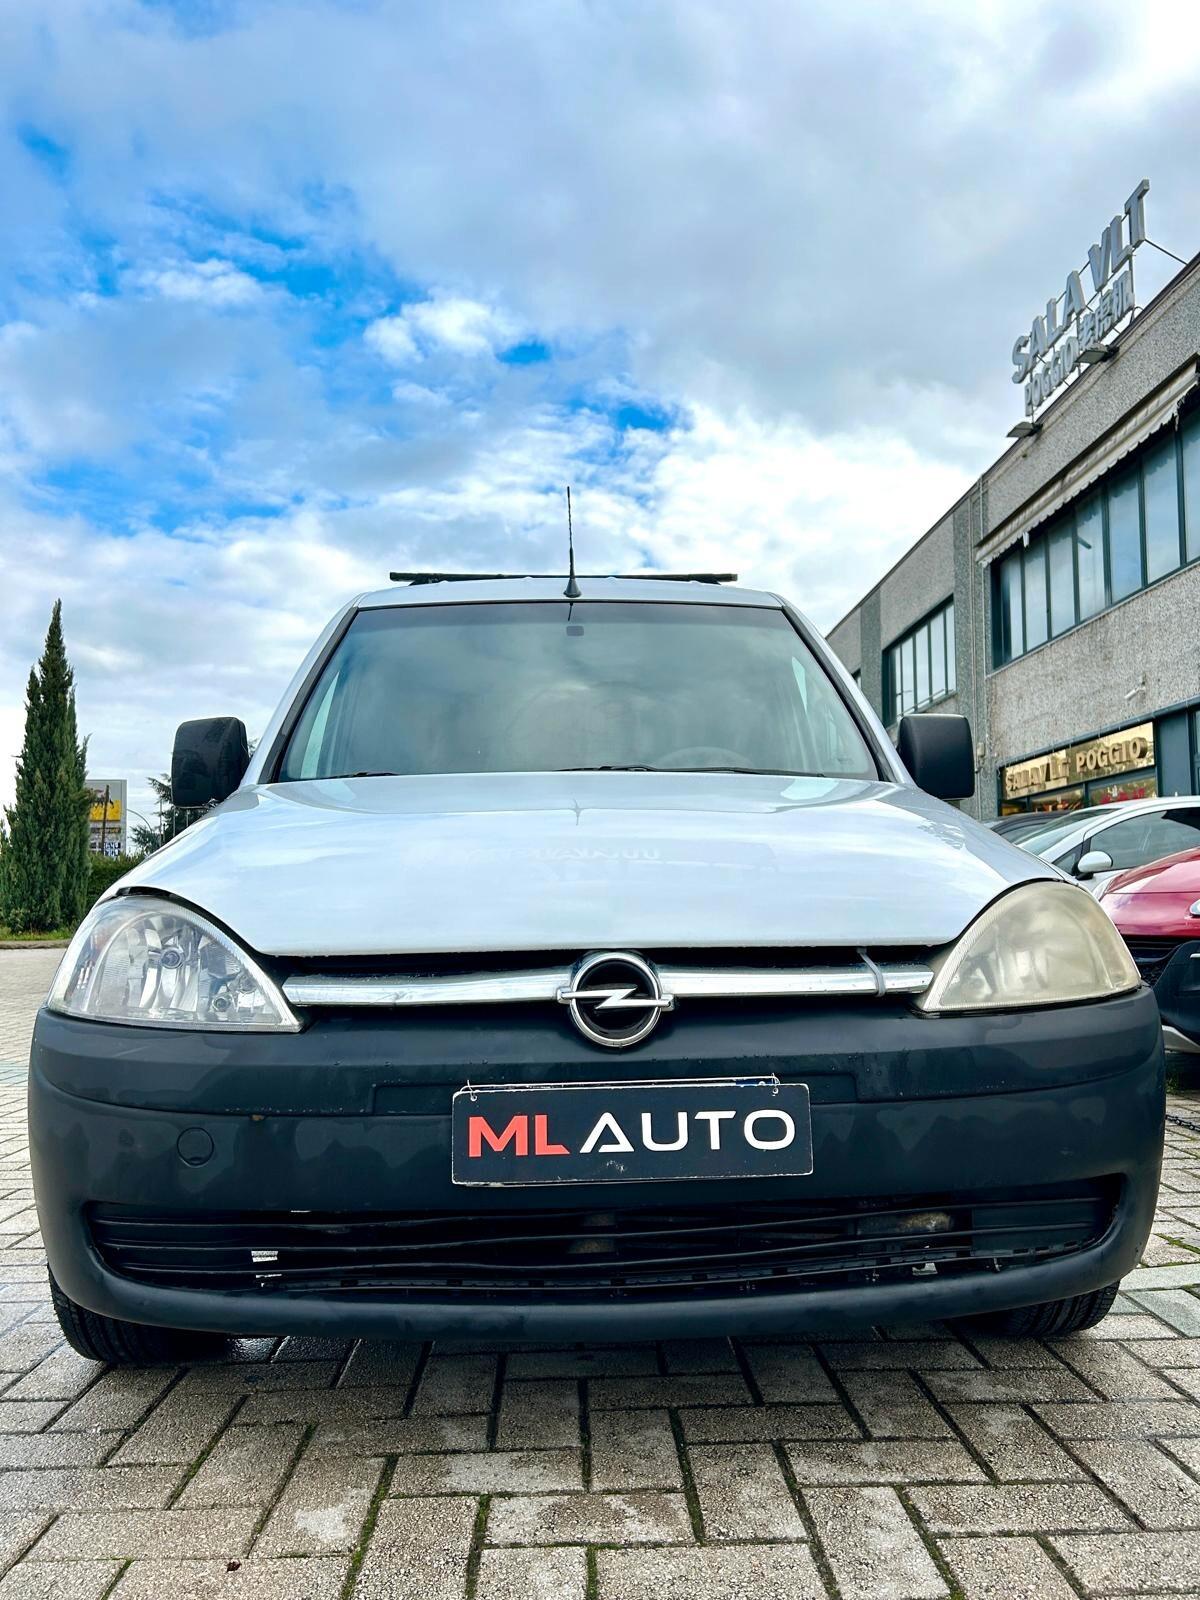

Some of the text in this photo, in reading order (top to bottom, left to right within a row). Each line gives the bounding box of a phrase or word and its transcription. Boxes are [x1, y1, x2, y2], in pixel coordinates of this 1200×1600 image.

[1012, 179, 1150, 384] SALA VLT
[1025, 336, 1080, 416] POGGIO
[1076, 737, 1147, 773] POGGIO
[468, 1109, 796, 1158] ML AUTO
